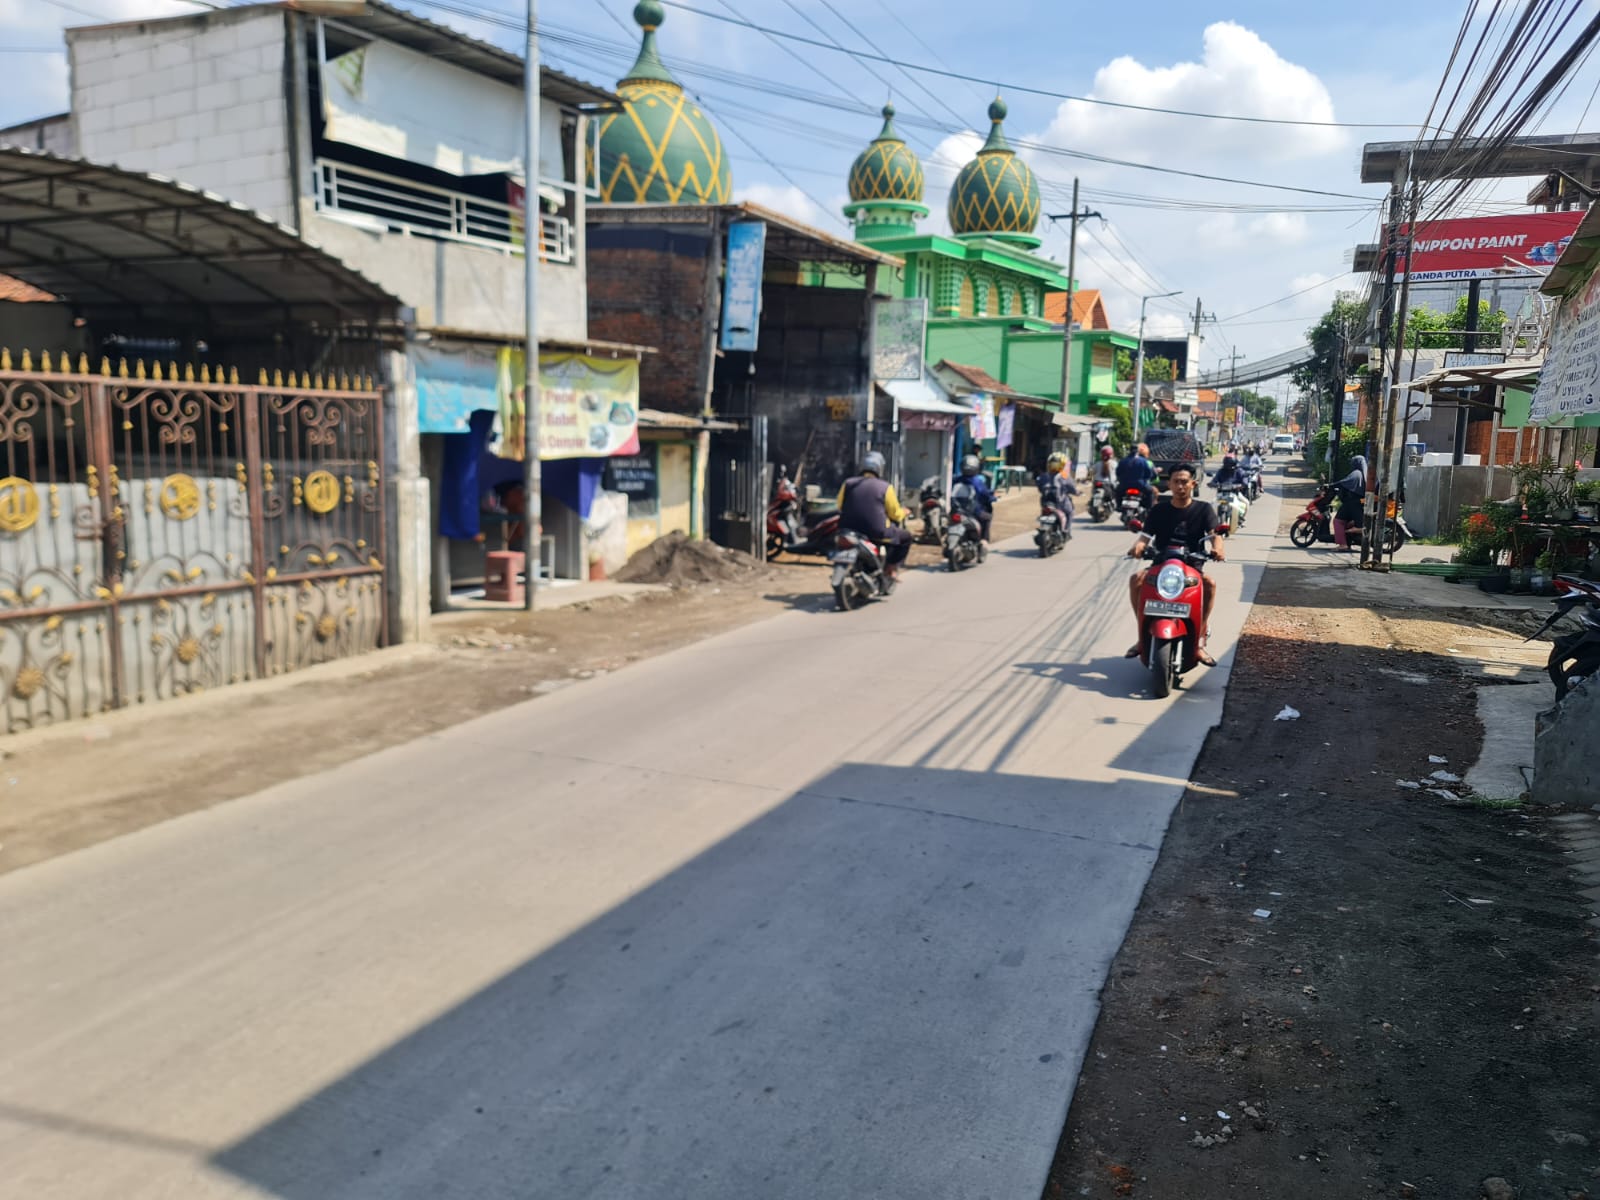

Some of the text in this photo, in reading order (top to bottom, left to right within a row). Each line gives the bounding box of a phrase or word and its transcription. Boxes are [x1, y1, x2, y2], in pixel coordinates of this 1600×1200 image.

[1412, 234, 1528, 252] NIPPON PAINT
[1409, 270, 1477, 280] GANDA PUTRA
